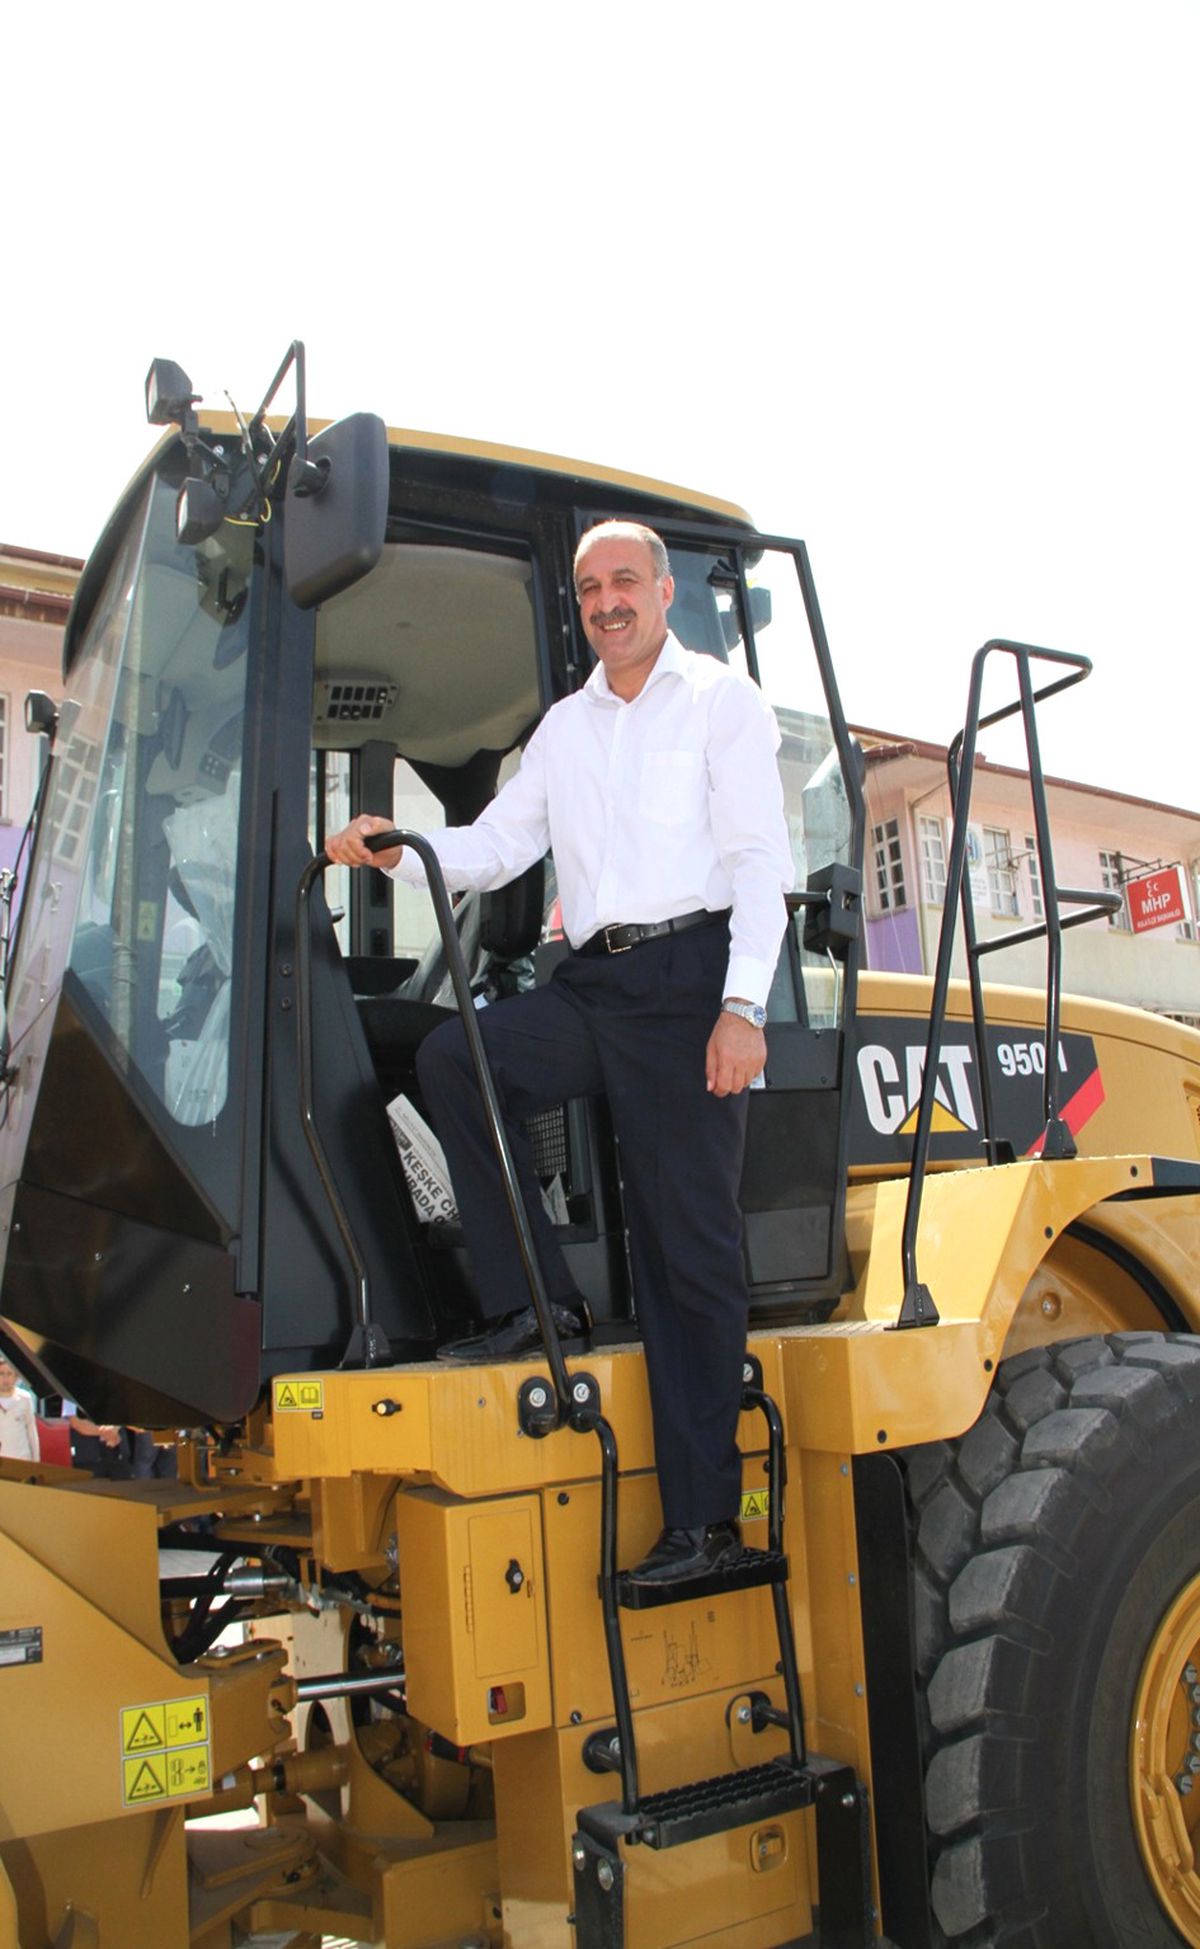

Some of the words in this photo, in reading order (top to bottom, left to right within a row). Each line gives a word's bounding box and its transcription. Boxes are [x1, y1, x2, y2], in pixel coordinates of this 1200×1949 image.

[1141, 893, 1171, 915] MHP
[856, 1044, 979, 1135] CAT
[403, 1151, 444, 1200] KEŞKE
[440, 1199, 461, 1223] CH
